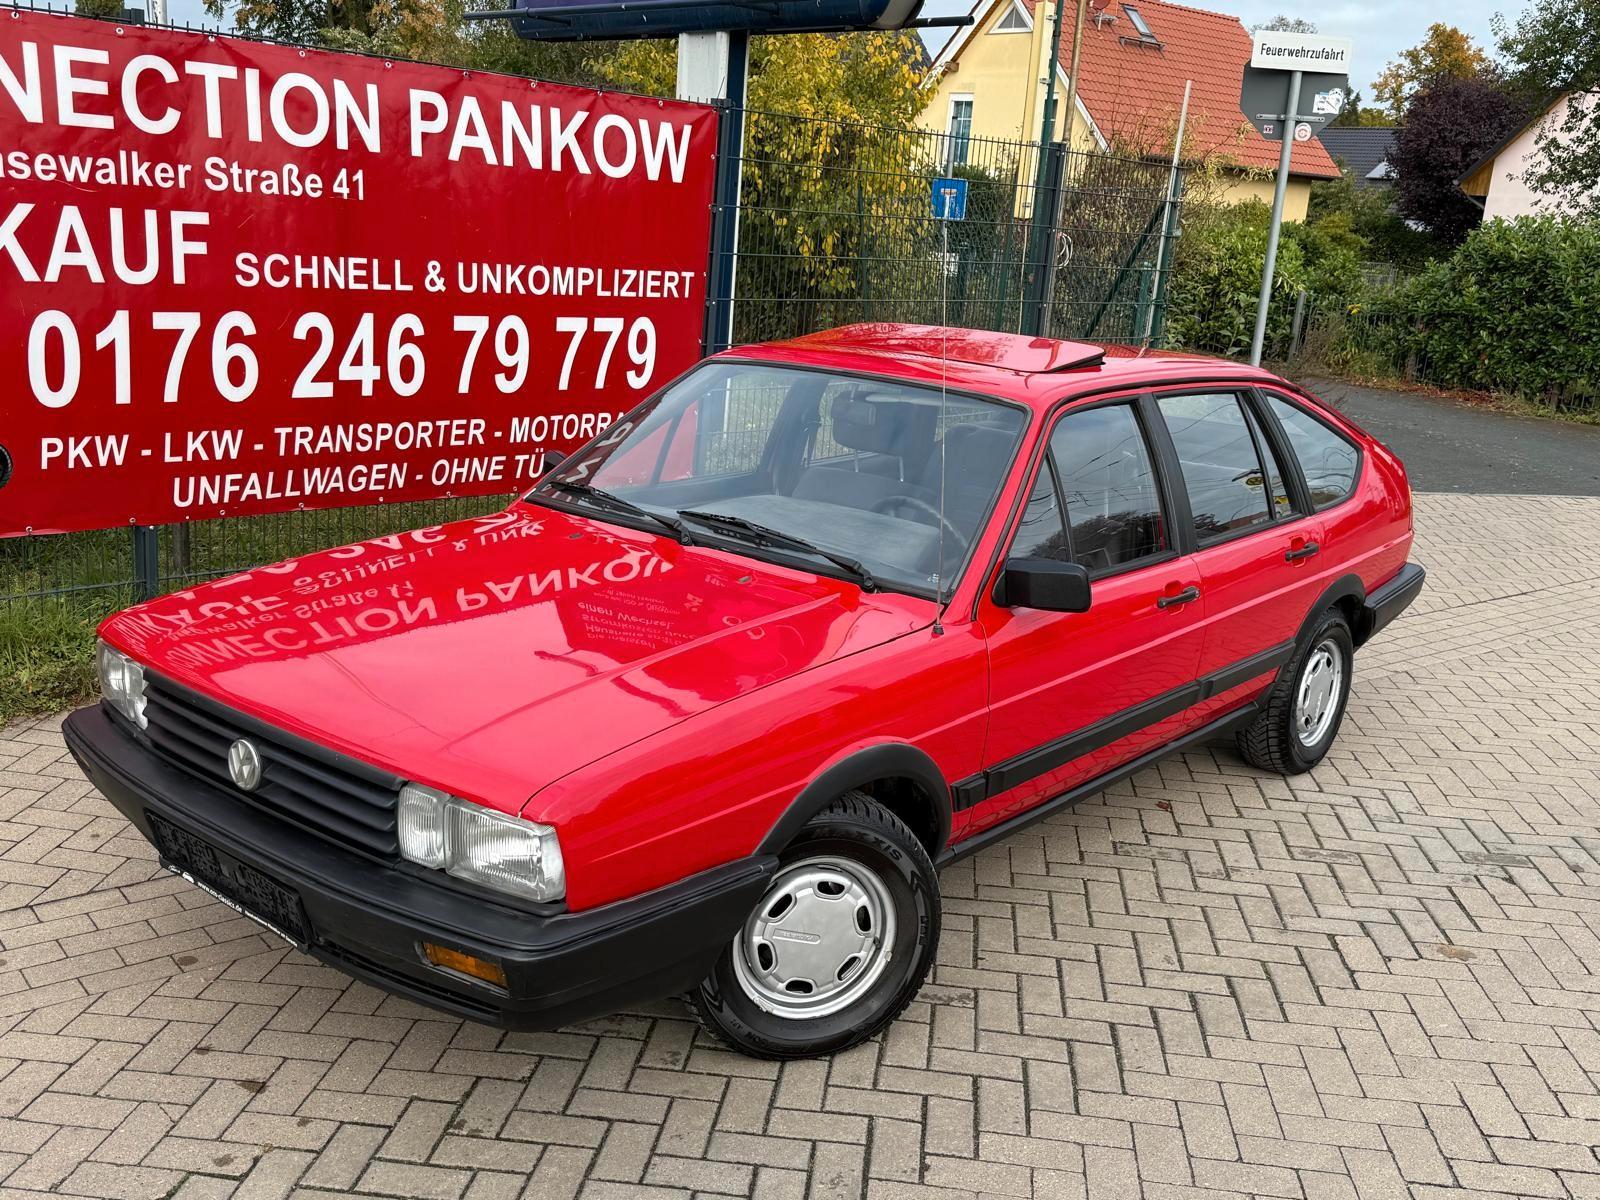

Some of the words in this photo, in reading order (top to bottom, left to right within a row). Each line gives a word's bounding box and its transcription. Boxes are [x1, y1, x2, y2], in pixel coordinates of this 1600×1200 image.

[1260, 43, 1345, 61] Feuerwehrzufahrt
[409, 88, 693, 184] PANKOW
[0, 150, 192, 192] sewalker
[204, 156, 323, 200] Straße
[332, 168, 364, 201] 41
[0, 203, 210, 285] KAUF
[235, 253, 414, 291] SCHNELL
[424, 261, 447, 293] &
[457, 262, 695, 299] UNKOMPLIZIERT
[28, 310, 259, 409] 0176
[291, 312, 426, 398] 246
[454, 315, 530, 393] 79
[556, 317, 656, 391] 779
[41, 435, 130, 470] PKW
[164, 430, 244, 463] LKW
[274, 419, 486, 457] TRANSPORTER
[173, 463, 407, 508] UNFALLWAGEN
[431, 456, 506, 486] OHNE
